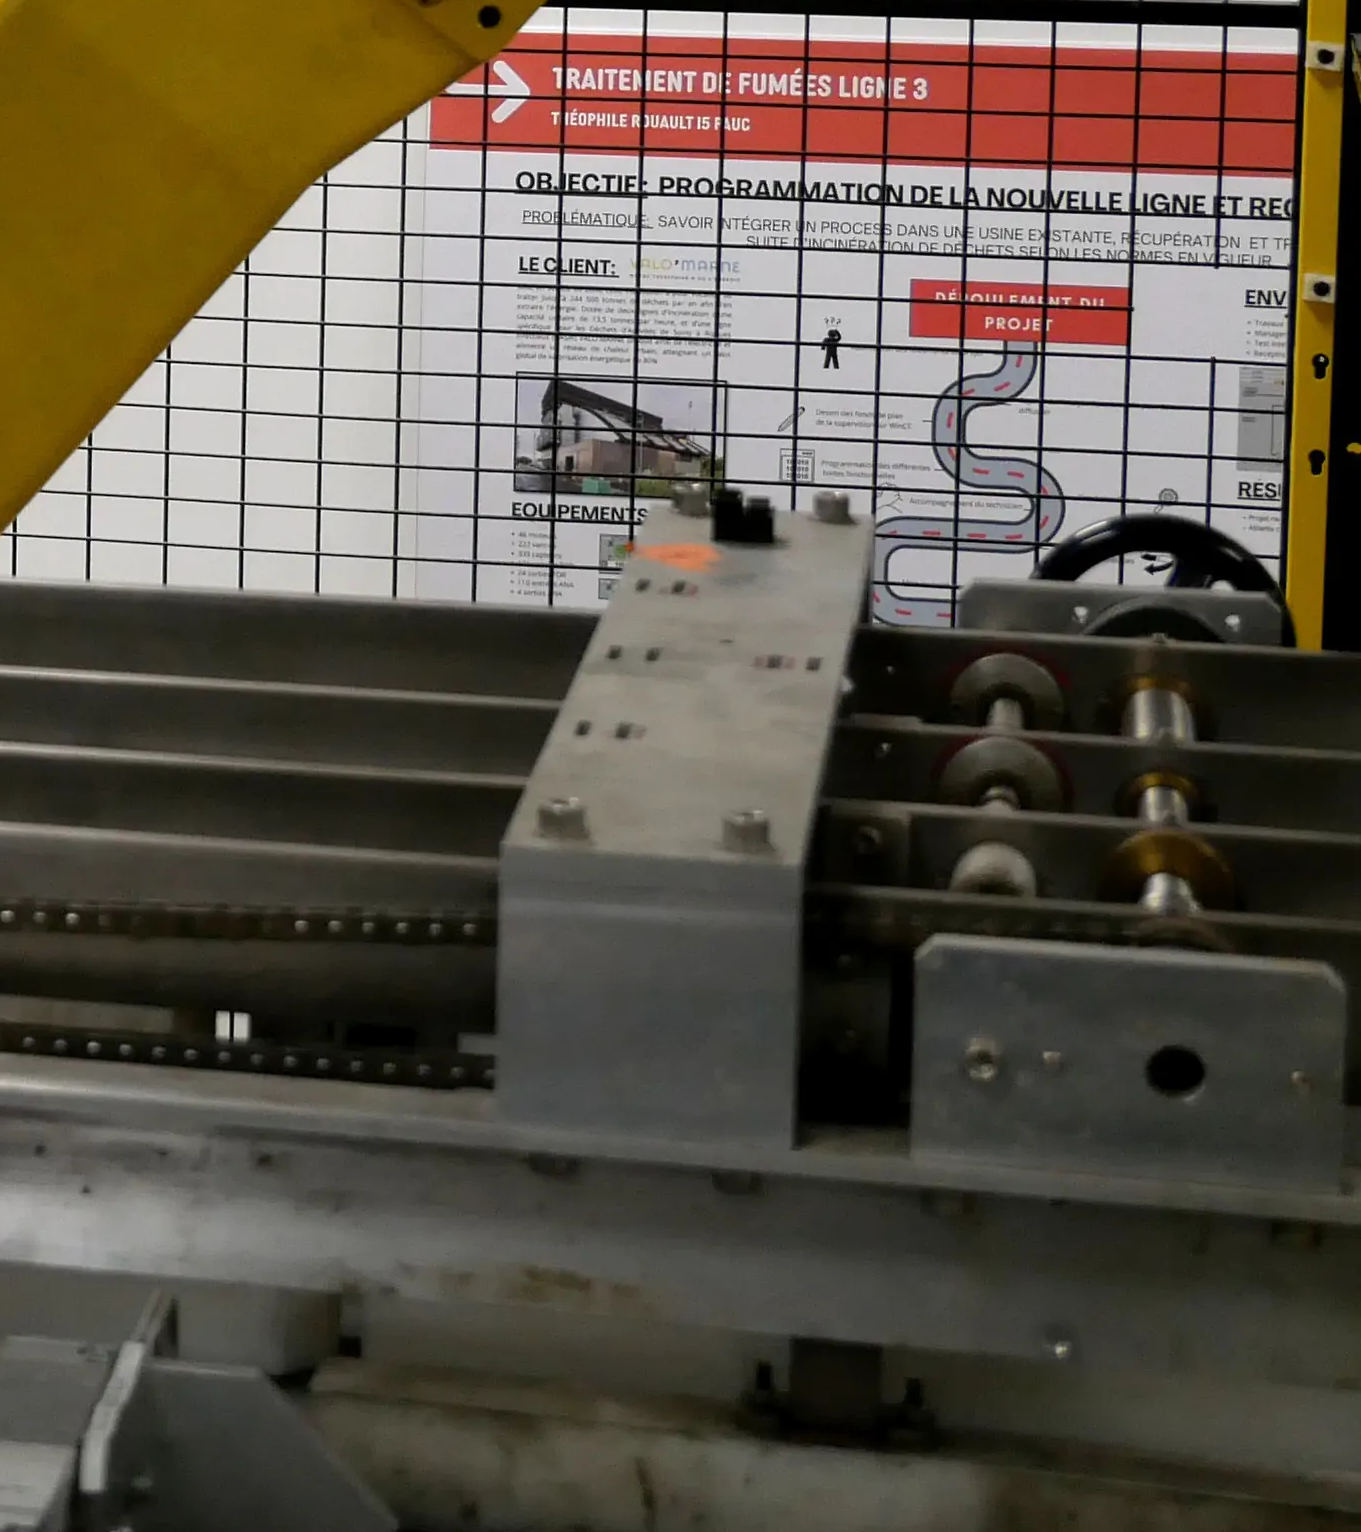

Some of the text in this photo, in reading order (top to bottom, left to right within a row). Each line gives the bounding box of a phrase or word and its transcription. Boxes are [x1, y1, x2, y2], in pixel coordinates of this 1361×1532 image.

[552, 66, 929, 101] TRAITEMENT DE FUMÉES LIGNE 3
[658, 175, 905, 205] PROGRAMMATION
[909, 184, 944, 206] DE
[949, 185, 981, 207] LA
[986, 187, 1122, 213] NOUVELLE
[1131, 191, 1207, 216] LIGNE
[1213, 196, 1245, 217] ET
[657, 214, 714, 229] SAVOIR
[820, 220, 892, 237] PROCESS
[896, 224, 940, 238] DANS
[944, 225, 975, 240] UNE
[979, 228, 1024, 242] USINE
[1249, 237, 1269, 251] ET
[918, 241, 940, 255] DE
[518, 256, 618, 277] LE CLIENT:
[984, 316, 1054, 332] PROJET
